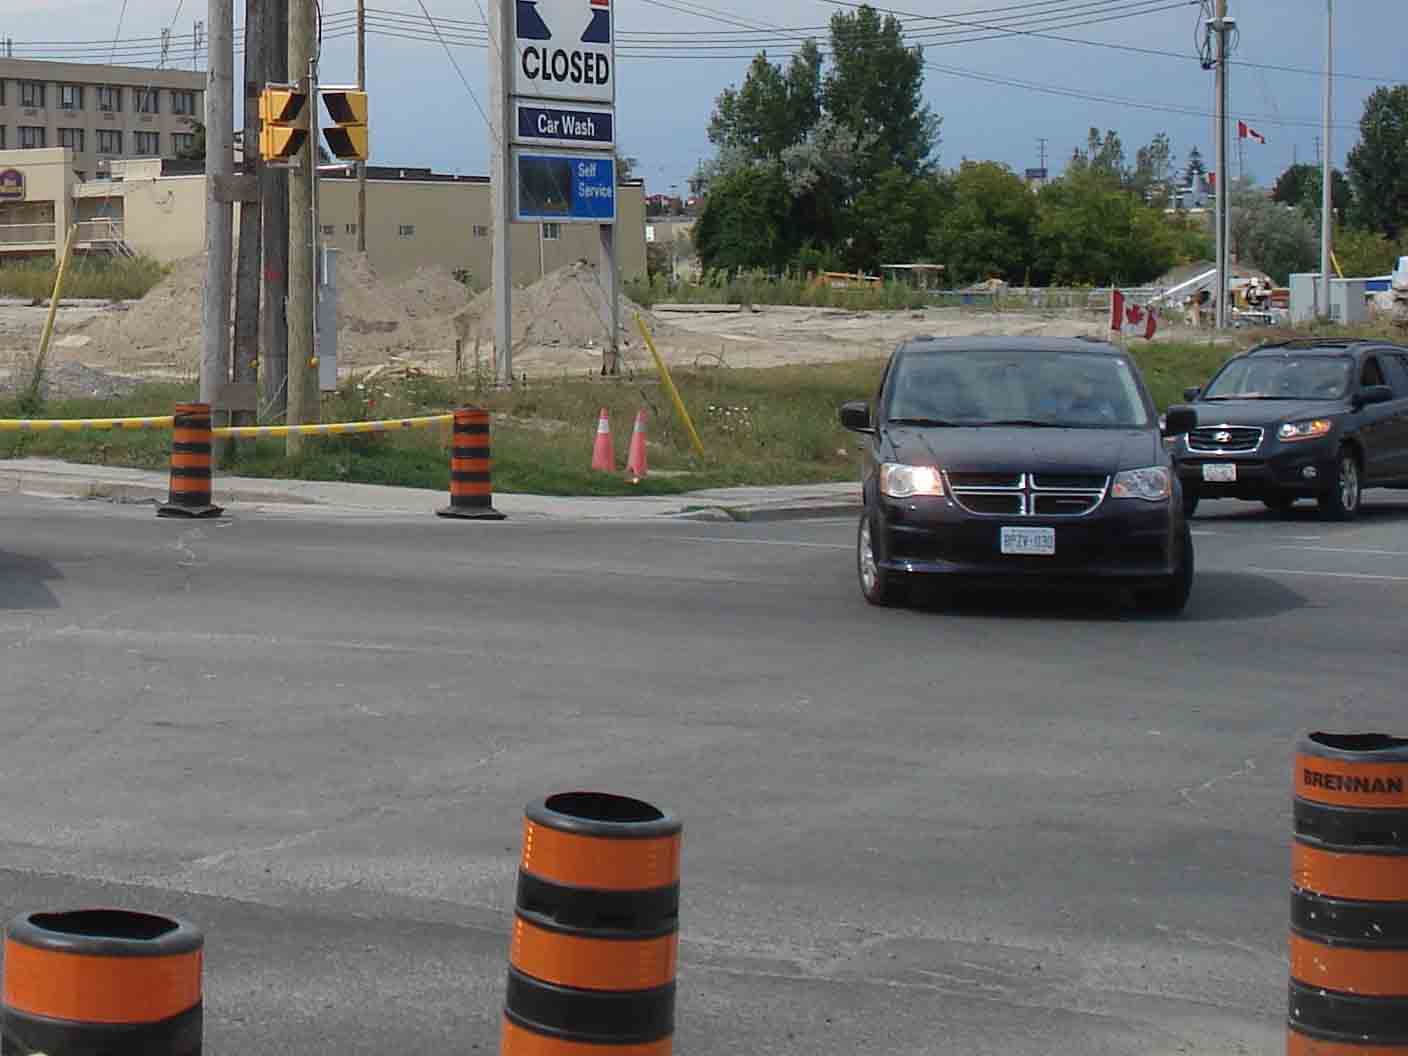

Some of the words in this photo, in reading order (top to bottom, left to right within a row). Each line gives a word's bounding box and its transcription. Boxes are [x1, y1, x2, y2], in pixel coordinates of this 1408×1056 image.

[522, 46, 610, 85] CLOSED
[537, 113, 560, 135] Car
[561, 116, 595, 137] Wash
[578, 162, 597, 178] Self
[578, 182, 612, 199] Service
[1303, 768, 1403, 793] BRENNAN
